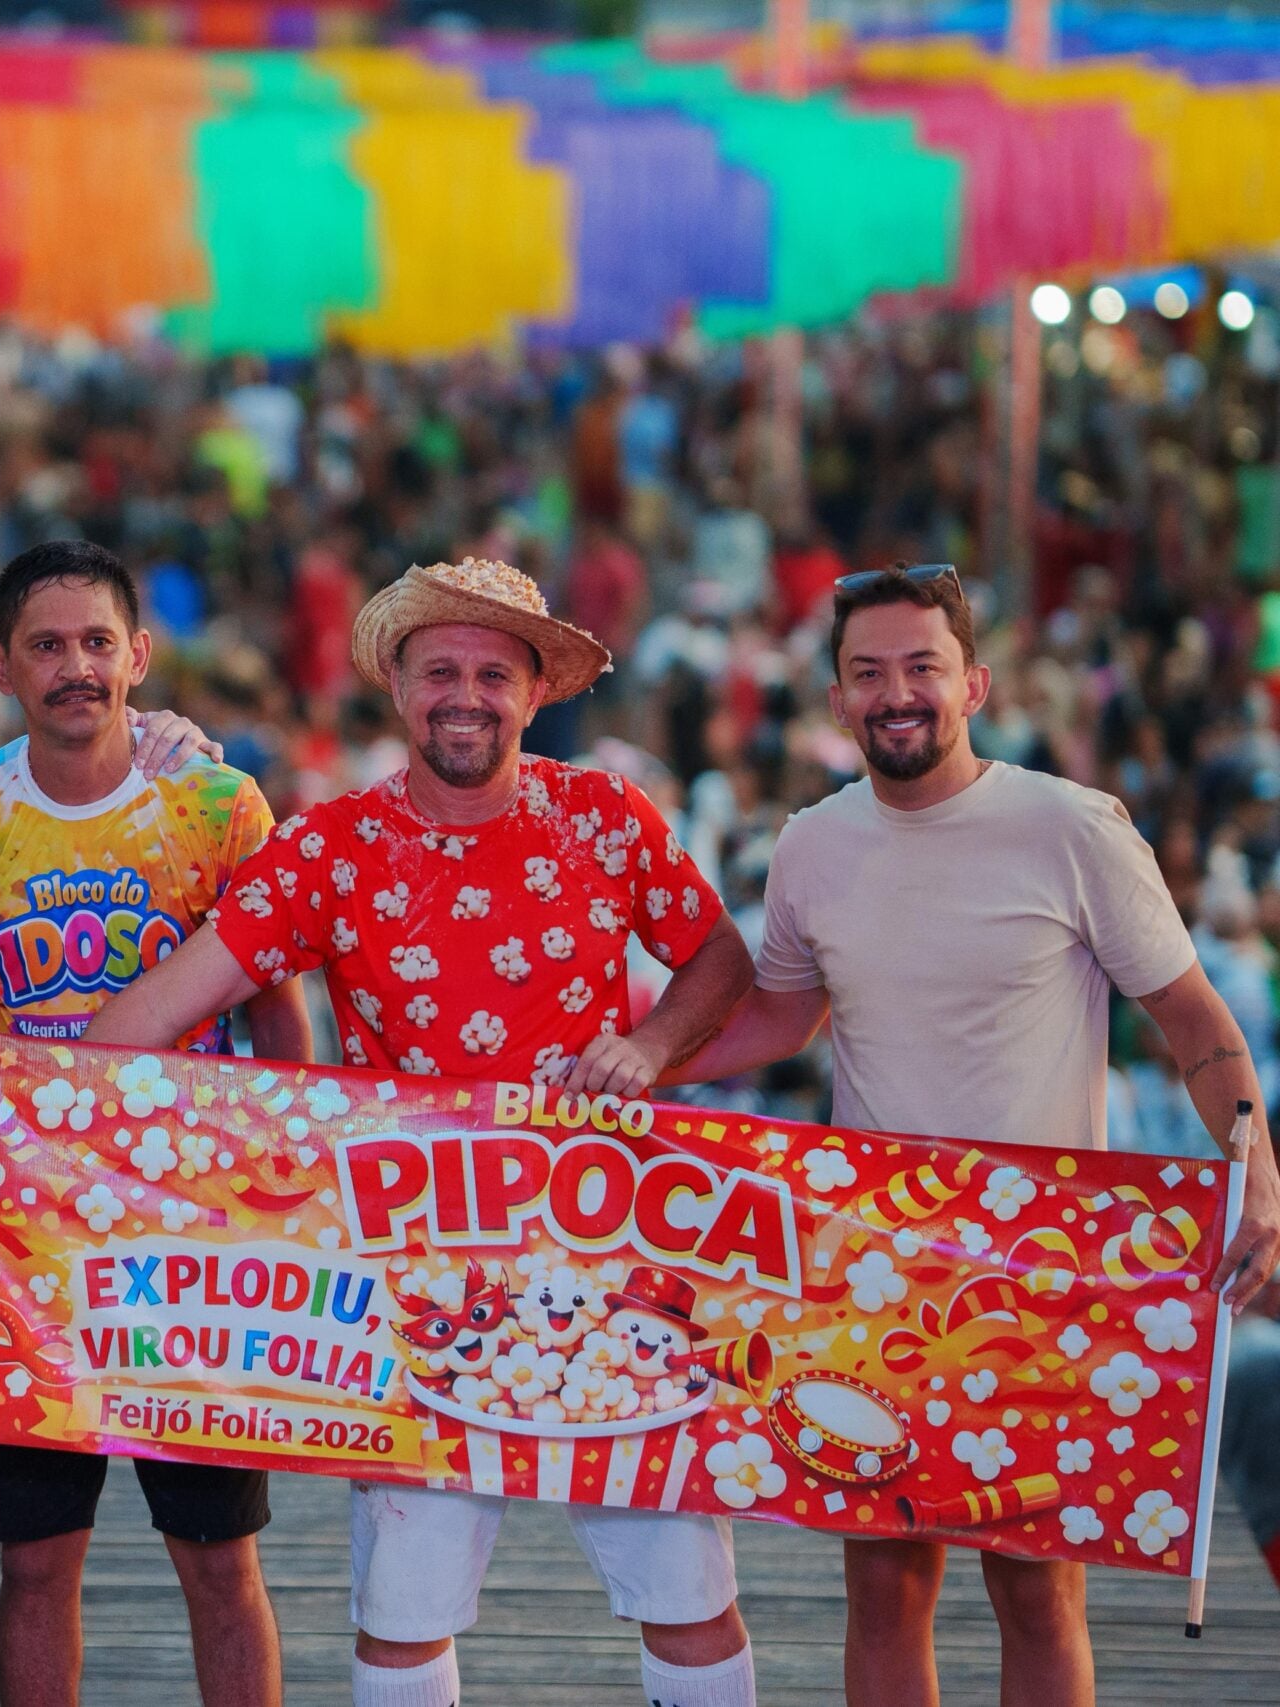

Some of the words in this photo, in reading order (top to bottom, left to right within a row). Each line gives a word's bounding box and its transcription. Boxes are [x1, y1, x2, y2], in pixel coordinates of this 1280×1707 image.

[31, 874, 105, 912] Bloco
[110, 871, 145, 906] do
[19, 1020, 67, 1038] Alegria
[493, 1081, 655, 1138] BLOCO
[345, 1138, 793, 1289] PIPOCA
[83, 1255, 381, 1336] EXPLODIU,
[80, 1325, 231, 1370] VIROU
[242, 1329, 396, 1401] FOLIA!
[201, 1404, 293, 1444] Folía
[302, 1418, 394, 1455] 2026
